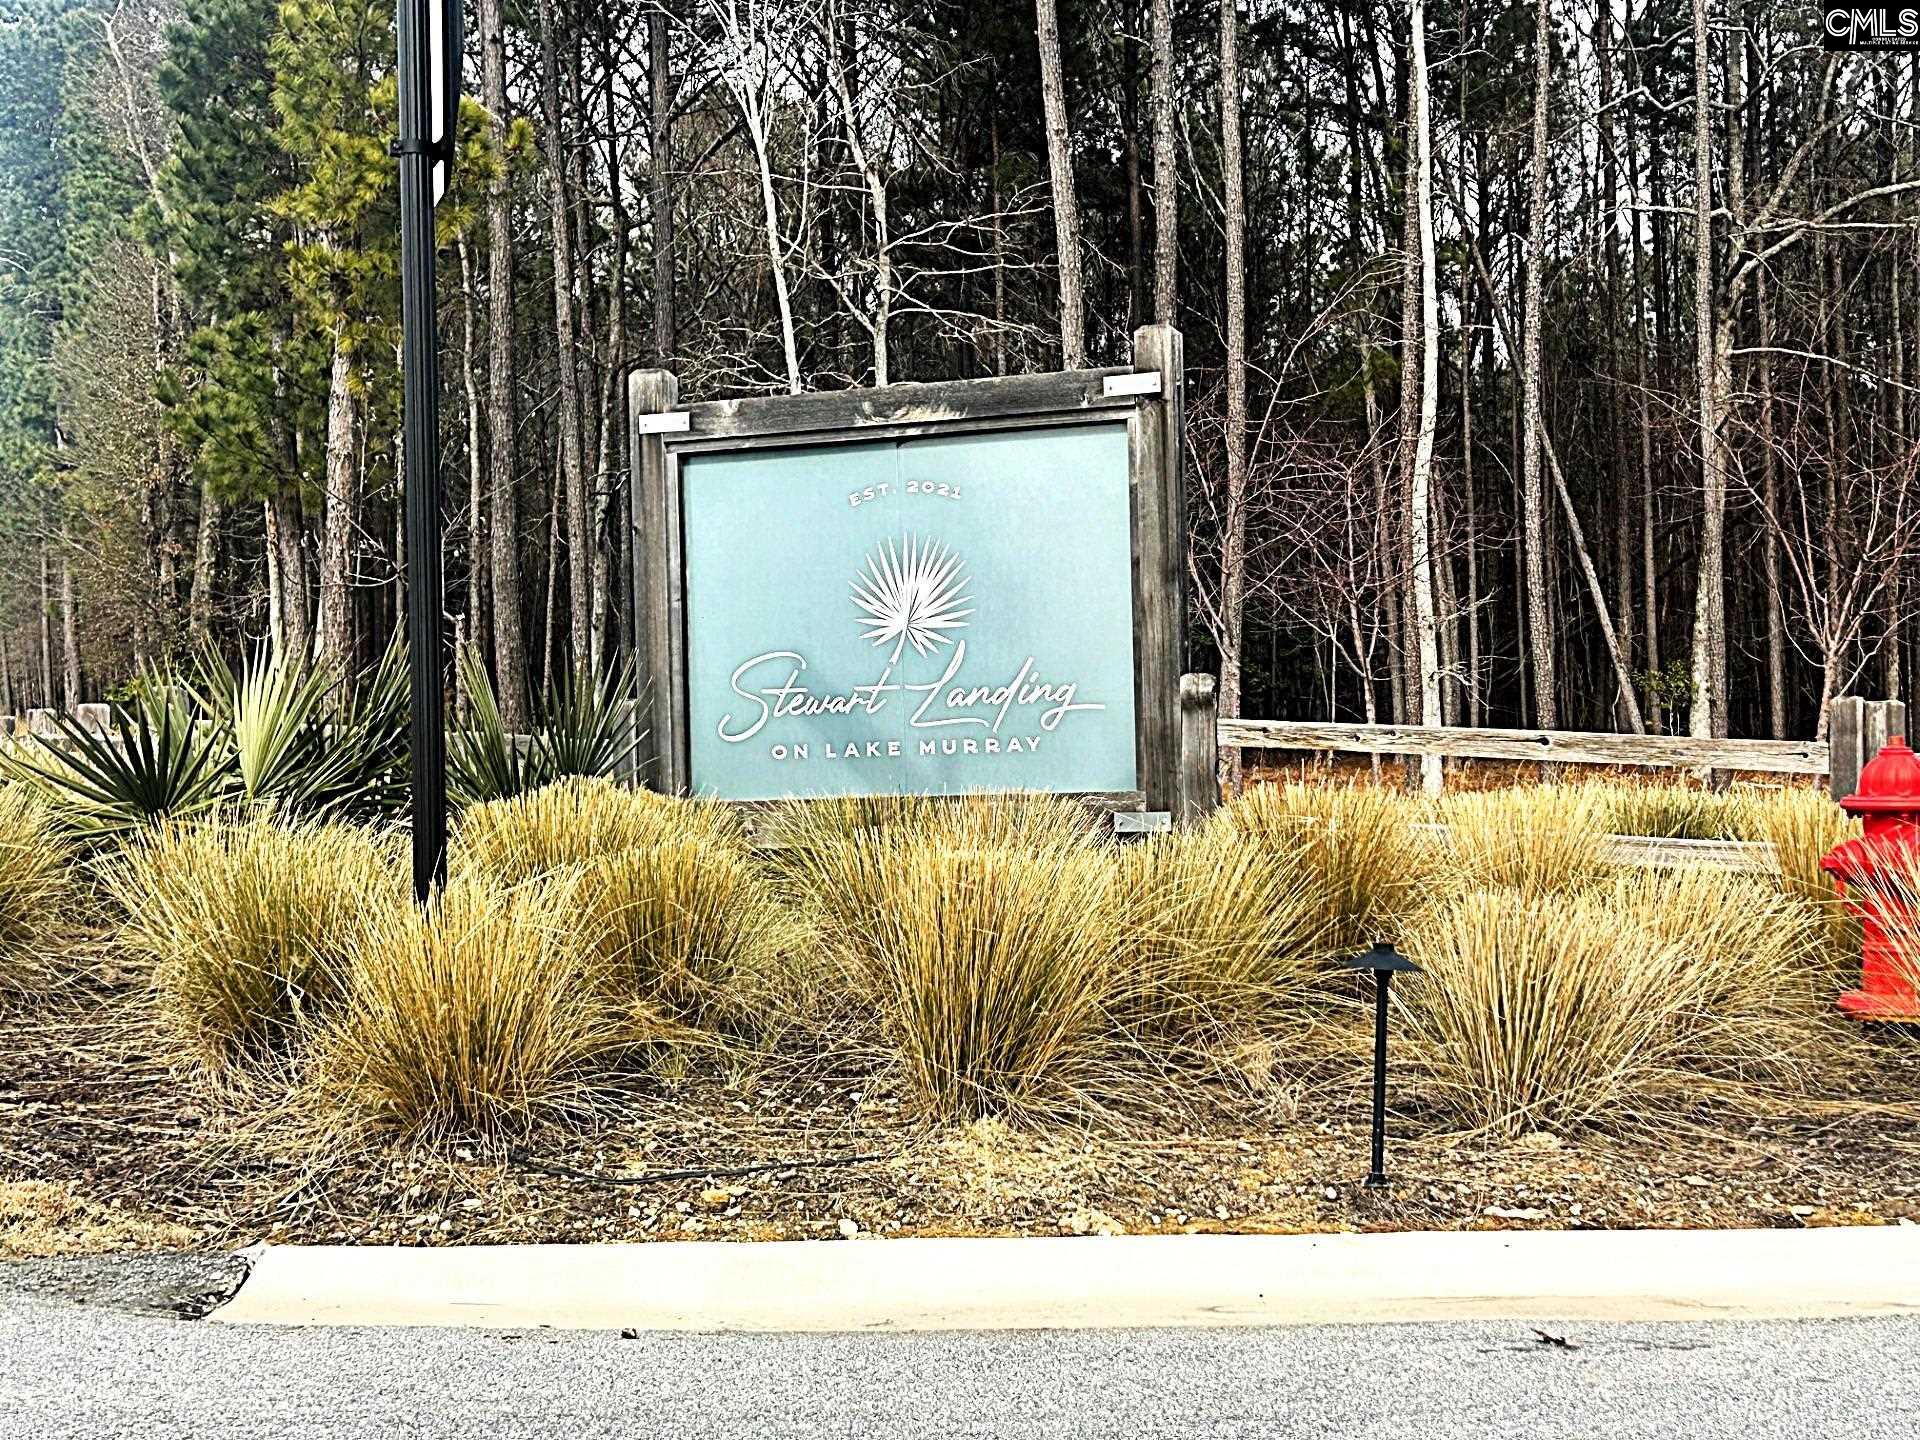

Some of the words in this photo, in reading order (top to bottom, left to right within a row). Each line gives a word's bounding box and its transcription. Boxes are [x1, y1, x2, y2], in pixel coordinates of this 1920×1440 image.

[848, 482, 897, 507] EST.
[905, 480, 961, 500] 2021
[717, 651, 901, 743] Stewart
[904, 640, 1106, 734] Landing
[771, 743, 809, 761] ON
[825, 740, 902, 760] LAKE
[919, 736, 1041, 757] MURRAY
